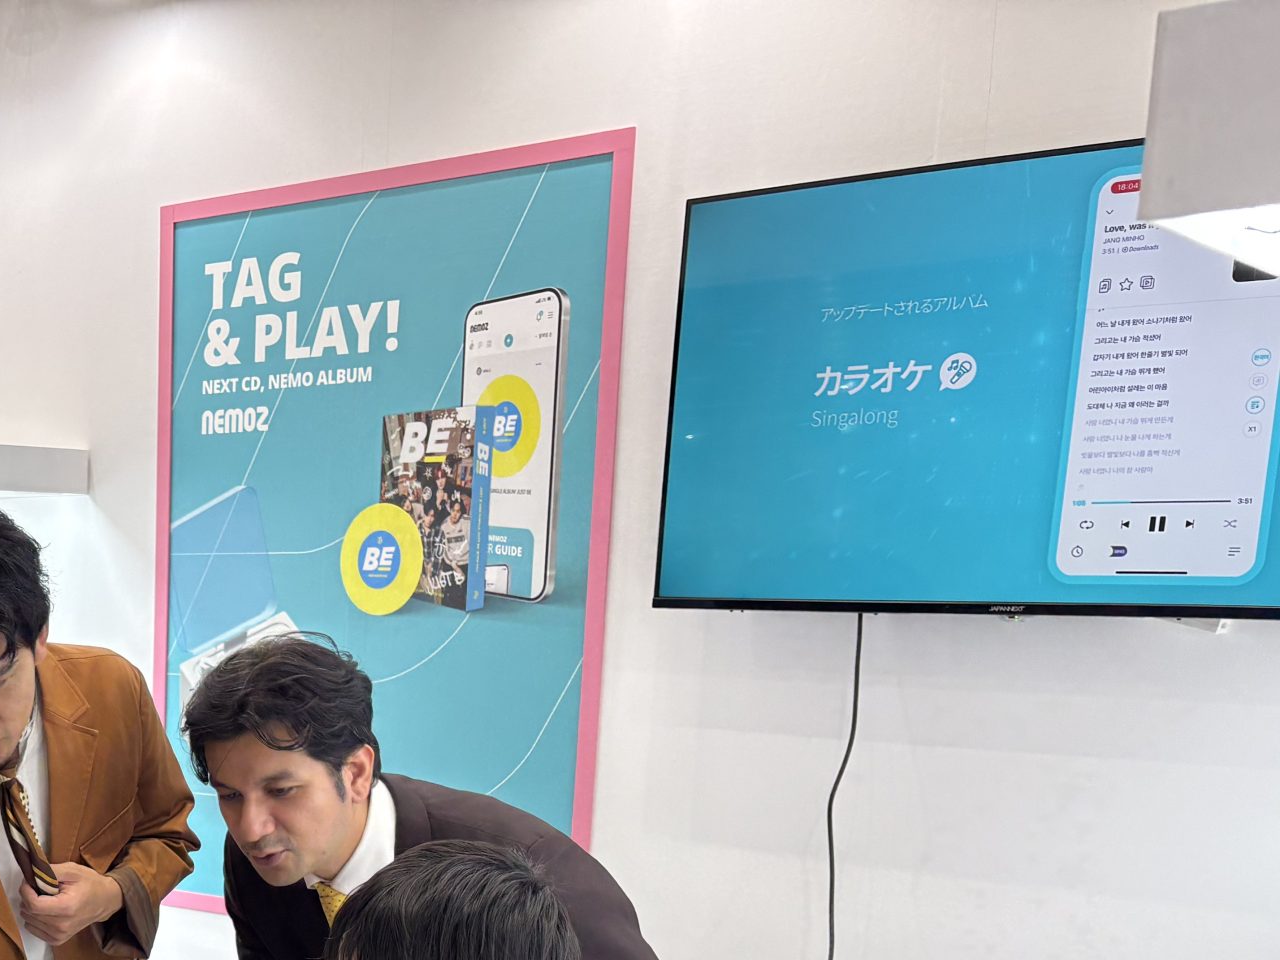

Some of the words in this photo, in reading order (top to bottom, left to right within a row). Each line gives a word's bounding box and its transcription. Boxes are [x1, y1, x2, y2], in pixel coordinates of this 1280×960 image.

[1104, 223, 1127, 233] Love,
[1129, 223, 1146, 231] was
[205, 252, 301, 310] TAG
[204, 319, 240, 367] &
[255, 300, 400, 362] PLAY!
[202, 379, 239, 395] NEXT
[241, 377, 263, 395] CD,
[268, 371, 313, 390] NEMO
[317, 366, 372, 386] ALBUM
[814, 360, 933, 397] カラオケ
[493, 415, 518, 438] BE
[811, 408, 899, 430] Singalong
[399, 419, 457, 464] BE
[362, 546, 395, 572] BE
[495, 543, 523, 558] GUIDE
